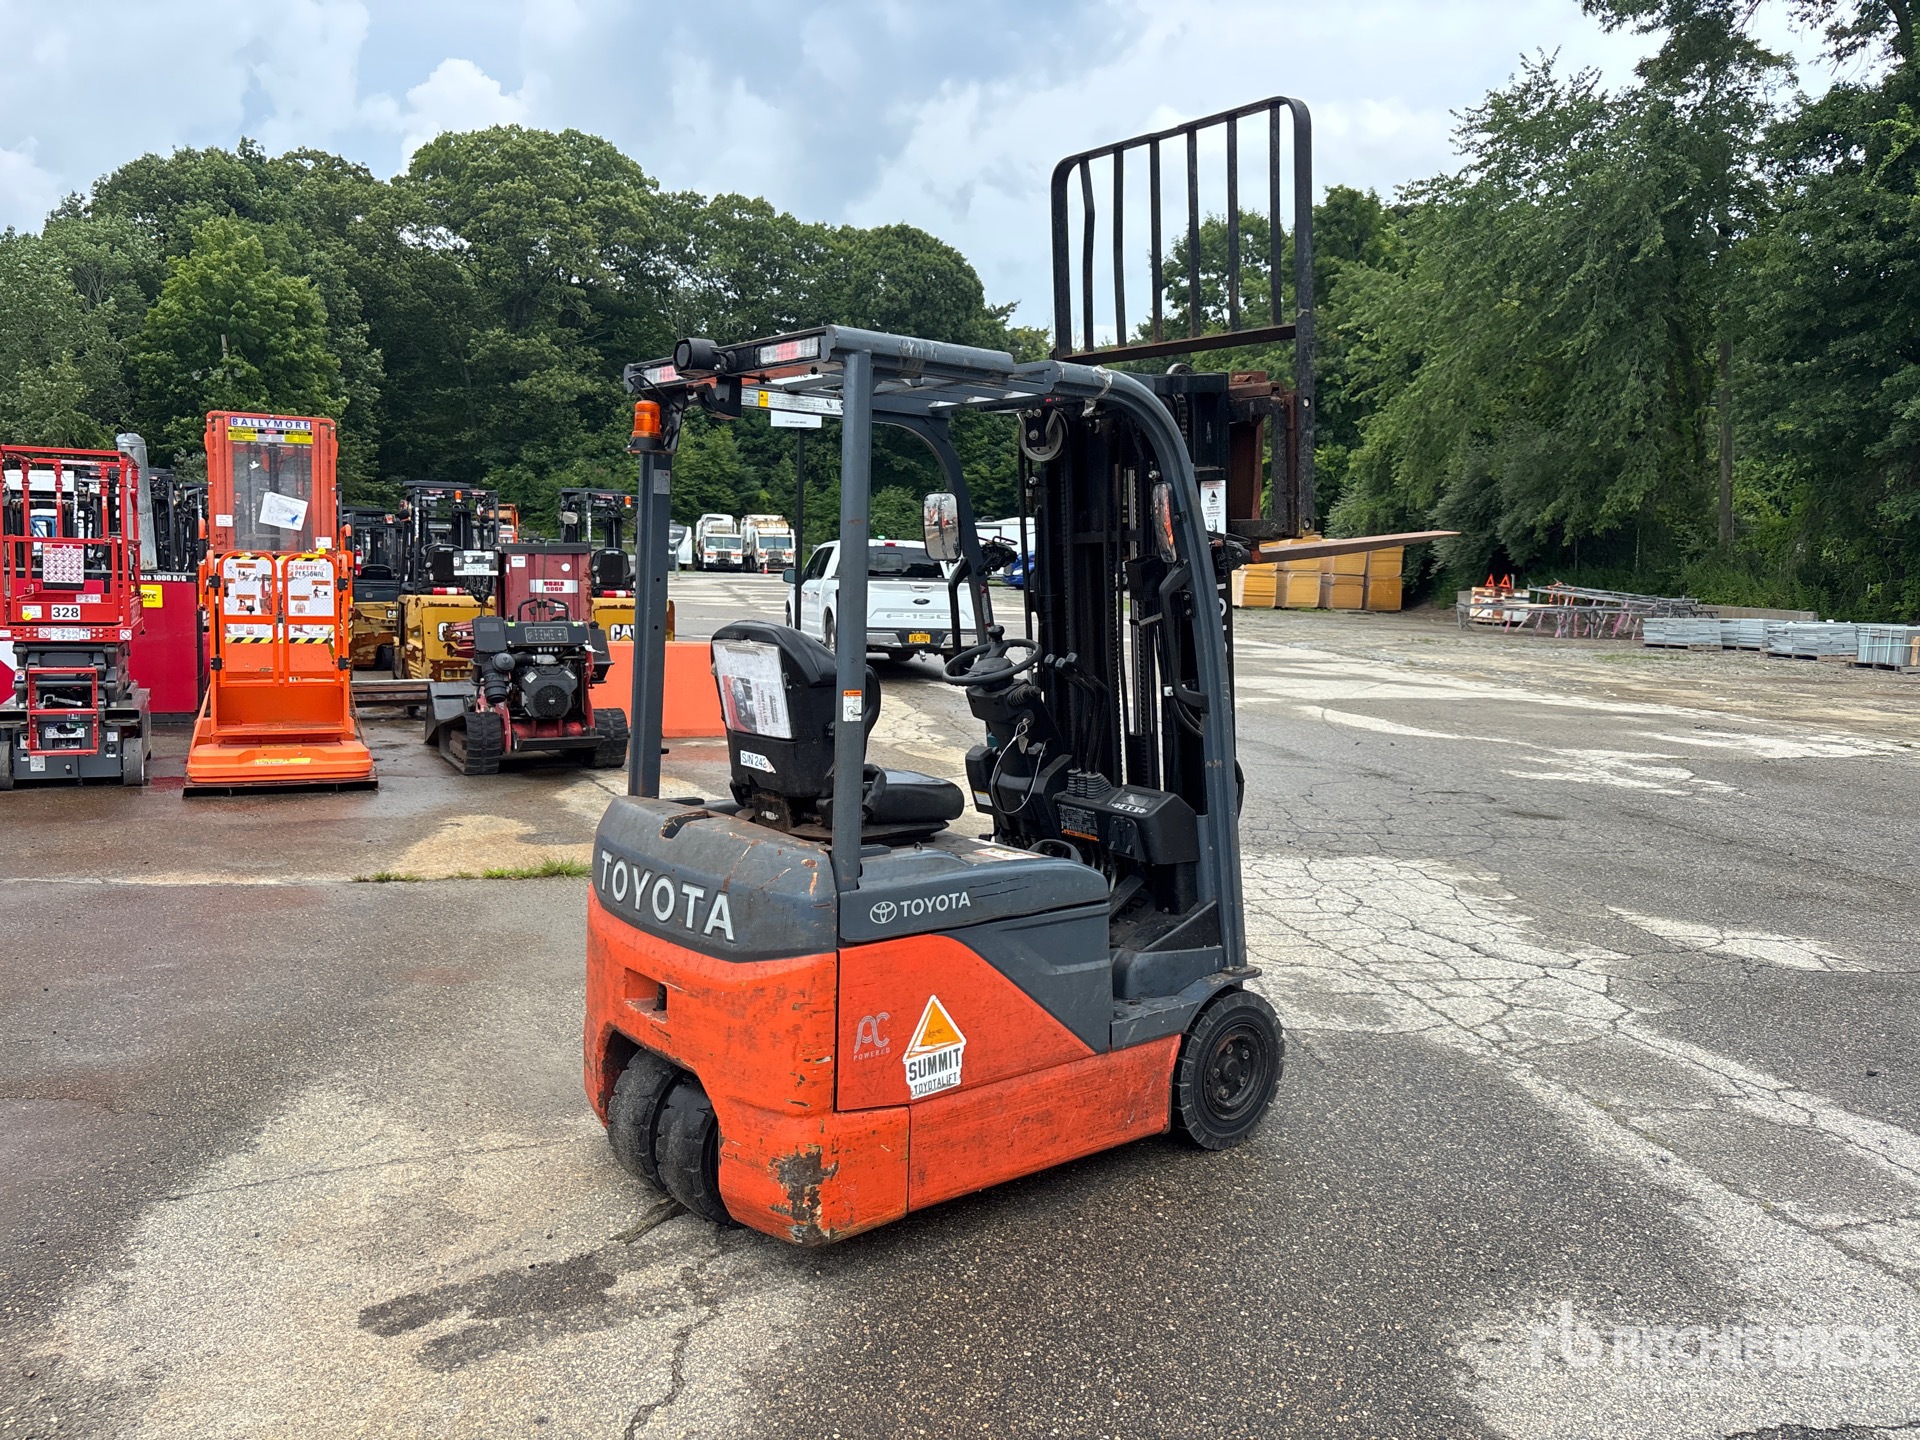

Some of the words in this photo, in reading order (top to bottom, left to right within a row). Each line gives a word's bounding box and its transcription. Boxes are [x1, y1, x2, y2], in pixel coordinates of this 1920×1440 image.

[232, 418, 309, 429] BALLYMORE
[153, 574, 172, 582] 1000
[52, 606, 79, 618] 328
[601, 850, 735, 941] TOYOTA
[900, 891, 971, 917] TOYOTA
[853, 1012, 891, 1054] AC
[853, 1047, 891, 1061] POWERED
[908, 1048, 961, 1082] SUMMIT
[913, 1071, 958, 1096] TOYOTALIFT
